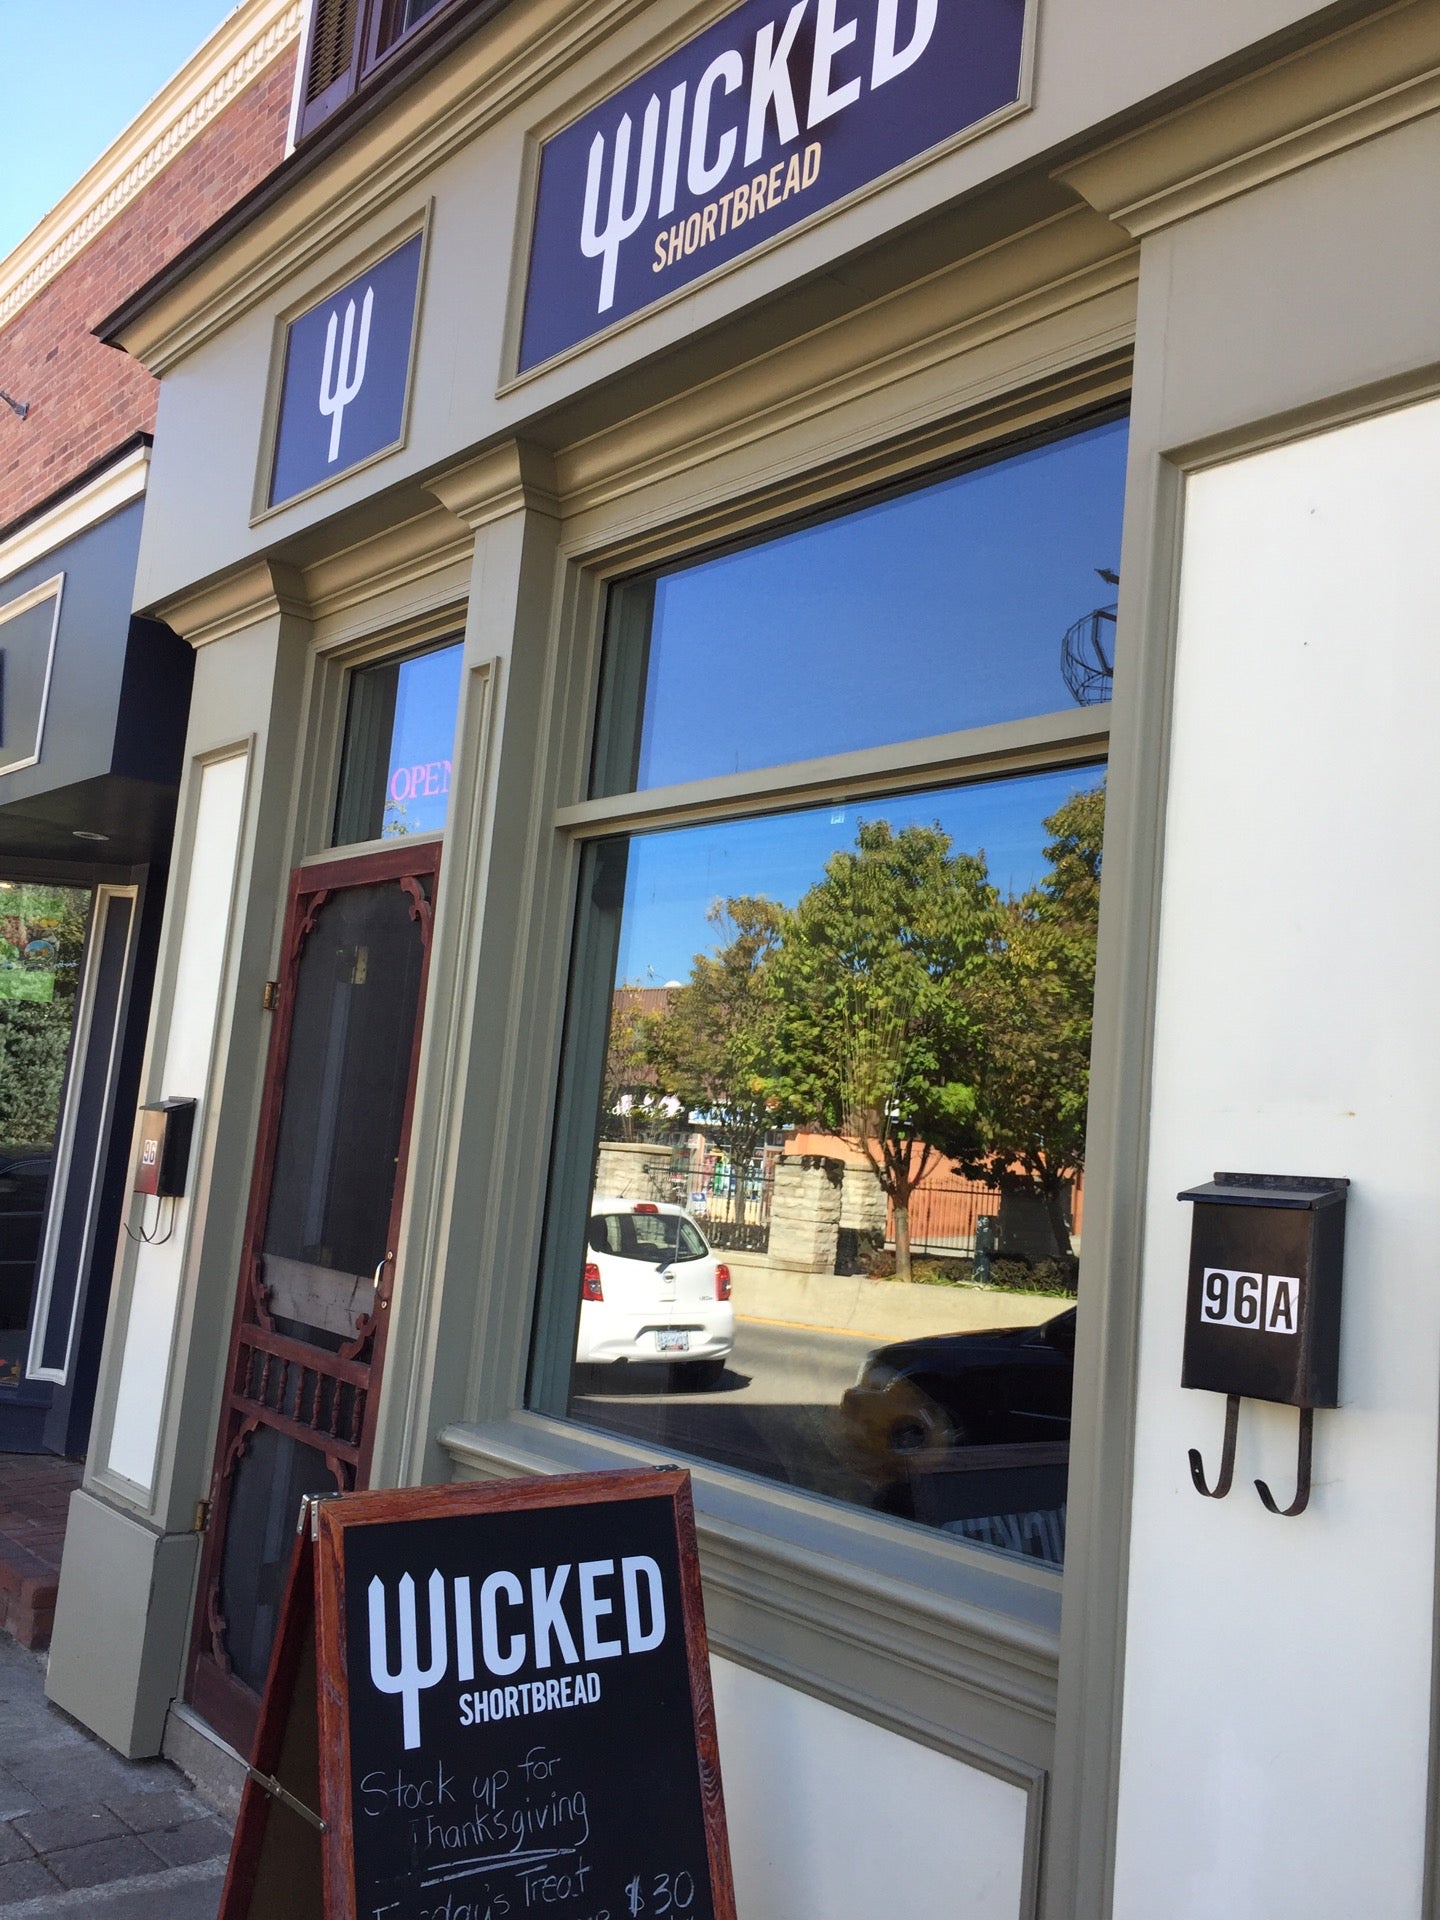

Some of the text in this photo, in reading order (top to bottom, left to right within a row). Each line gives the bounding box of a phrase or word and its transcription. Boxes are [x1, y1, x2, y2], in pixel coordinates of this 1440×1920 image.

[580, 0, 938, 314] WICKED
[652, 141, 822, 273] SHORTBREAD
[143, 1140, 157, 1164] 96
[1204, 1272, 1293, 1330] 96A
[367, 1554, 667, 1750] WICKED
[458, 1672, 602, 1726] SHORTBREAD
[360, 1746, 561, 1816] Stock up for
[408, 1791, 589, 1853] Thanksgiving
[515, 1856, 590, 1907] Treat
[625, 1870, 695, 1917] $30
